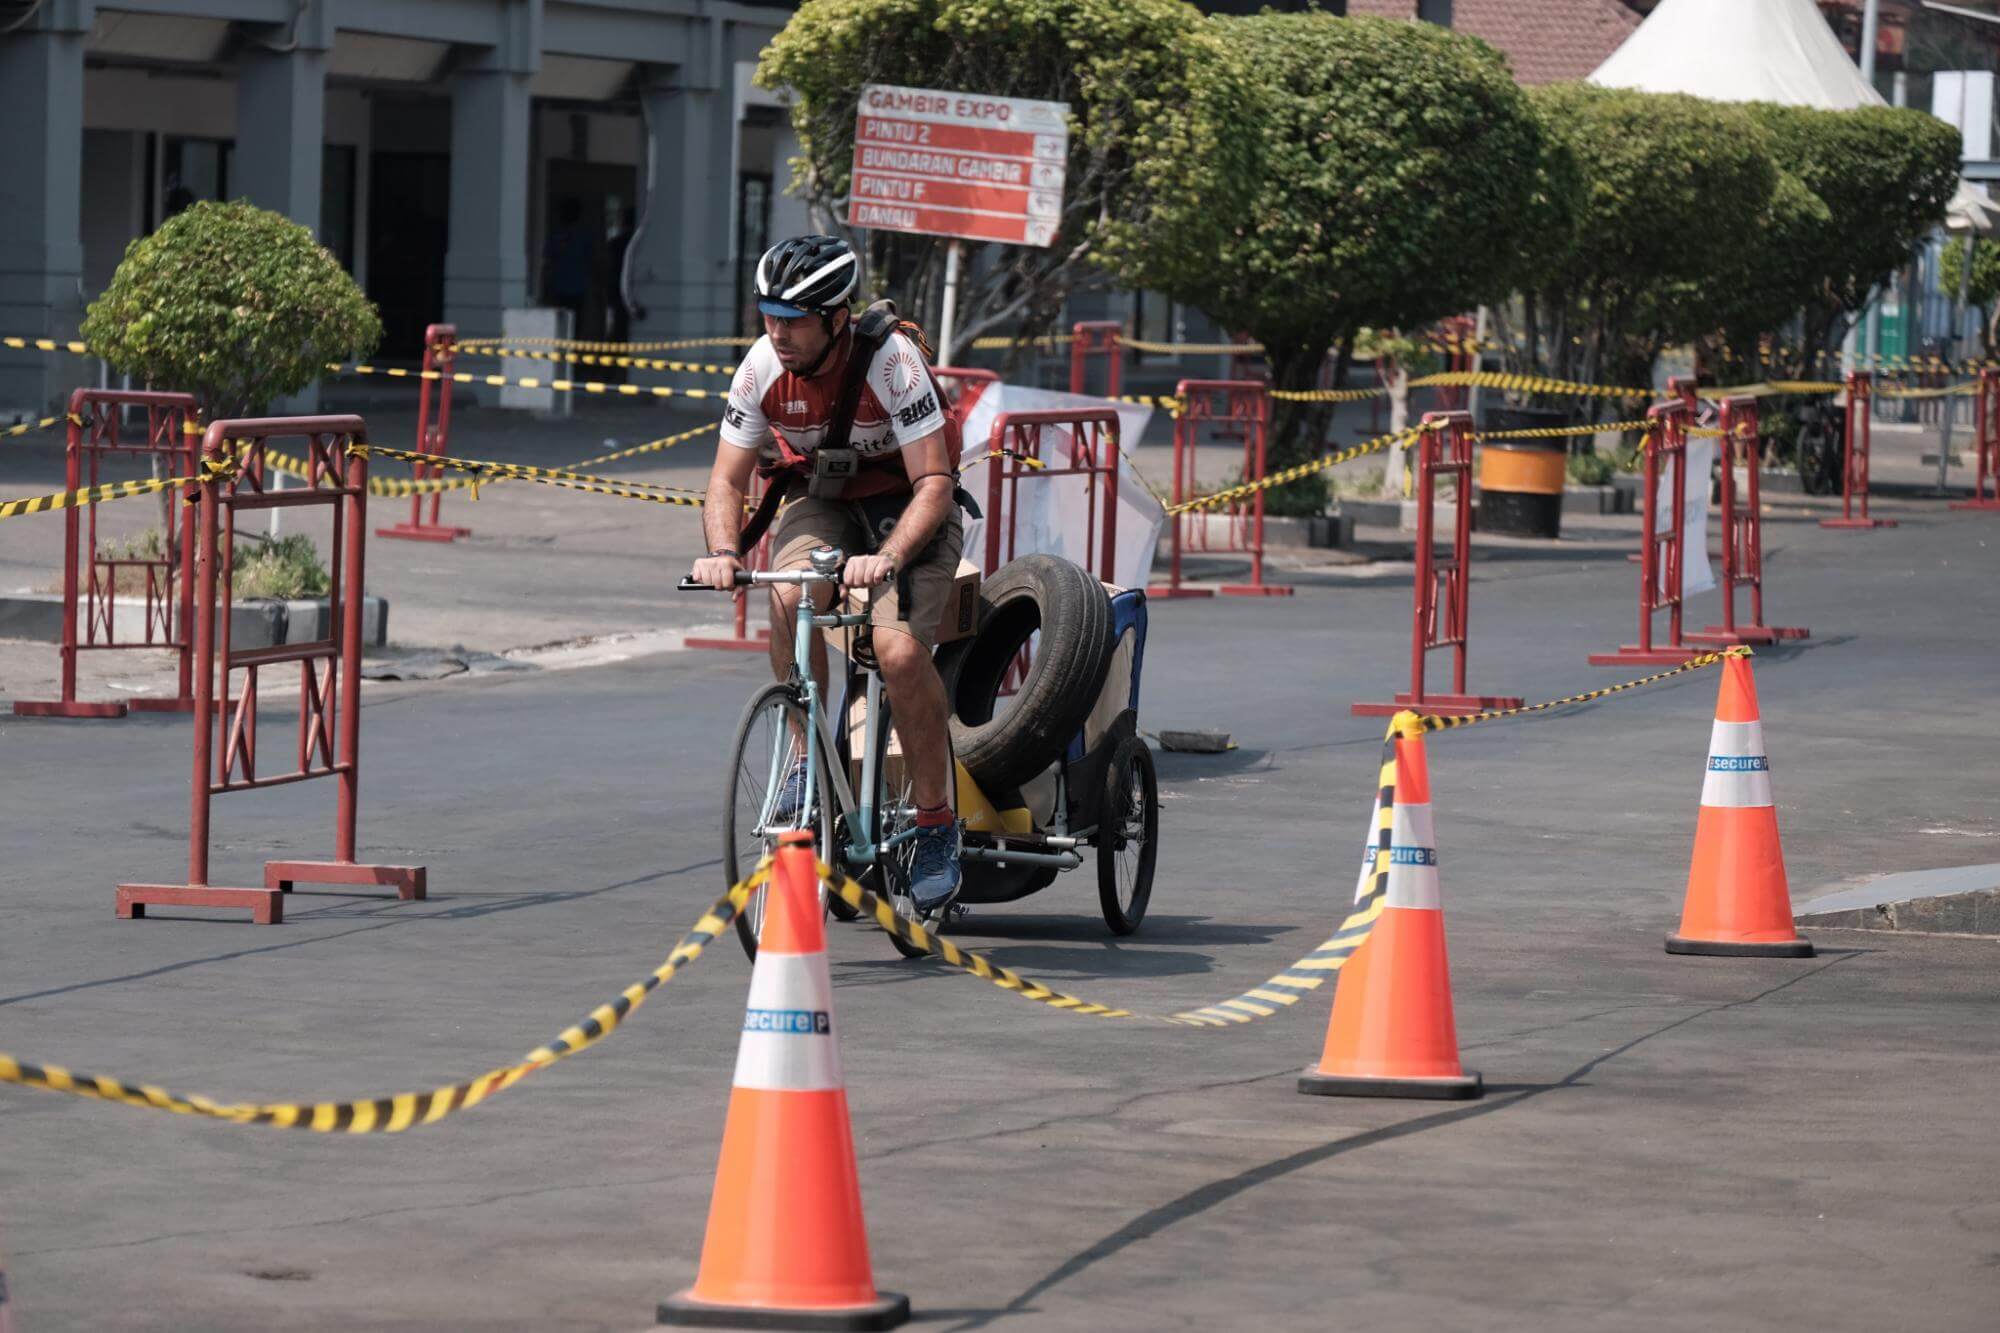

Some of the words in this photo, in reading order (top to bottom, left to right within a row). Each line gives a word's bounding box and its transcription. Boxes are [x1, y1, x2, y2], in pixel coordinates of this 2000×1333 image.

[868, 90, 948, 114] GAMBIR
[956, 100, 1010, 121] EXPO
[865, 120, 916, 142] PINTU
[918, 125, 930, 143] 2
[863, 147, 954, 175] BUNDARAN
[958, 158, 1022, 182] GAMBIR
[861, 176, 912, 199] PINTU
[913, 182, 926, 200] F
[858, 205, 917, 227] DANAU
[1714, 758, 1760, 769] secure
[1369, 847, 1424, 863] scure
